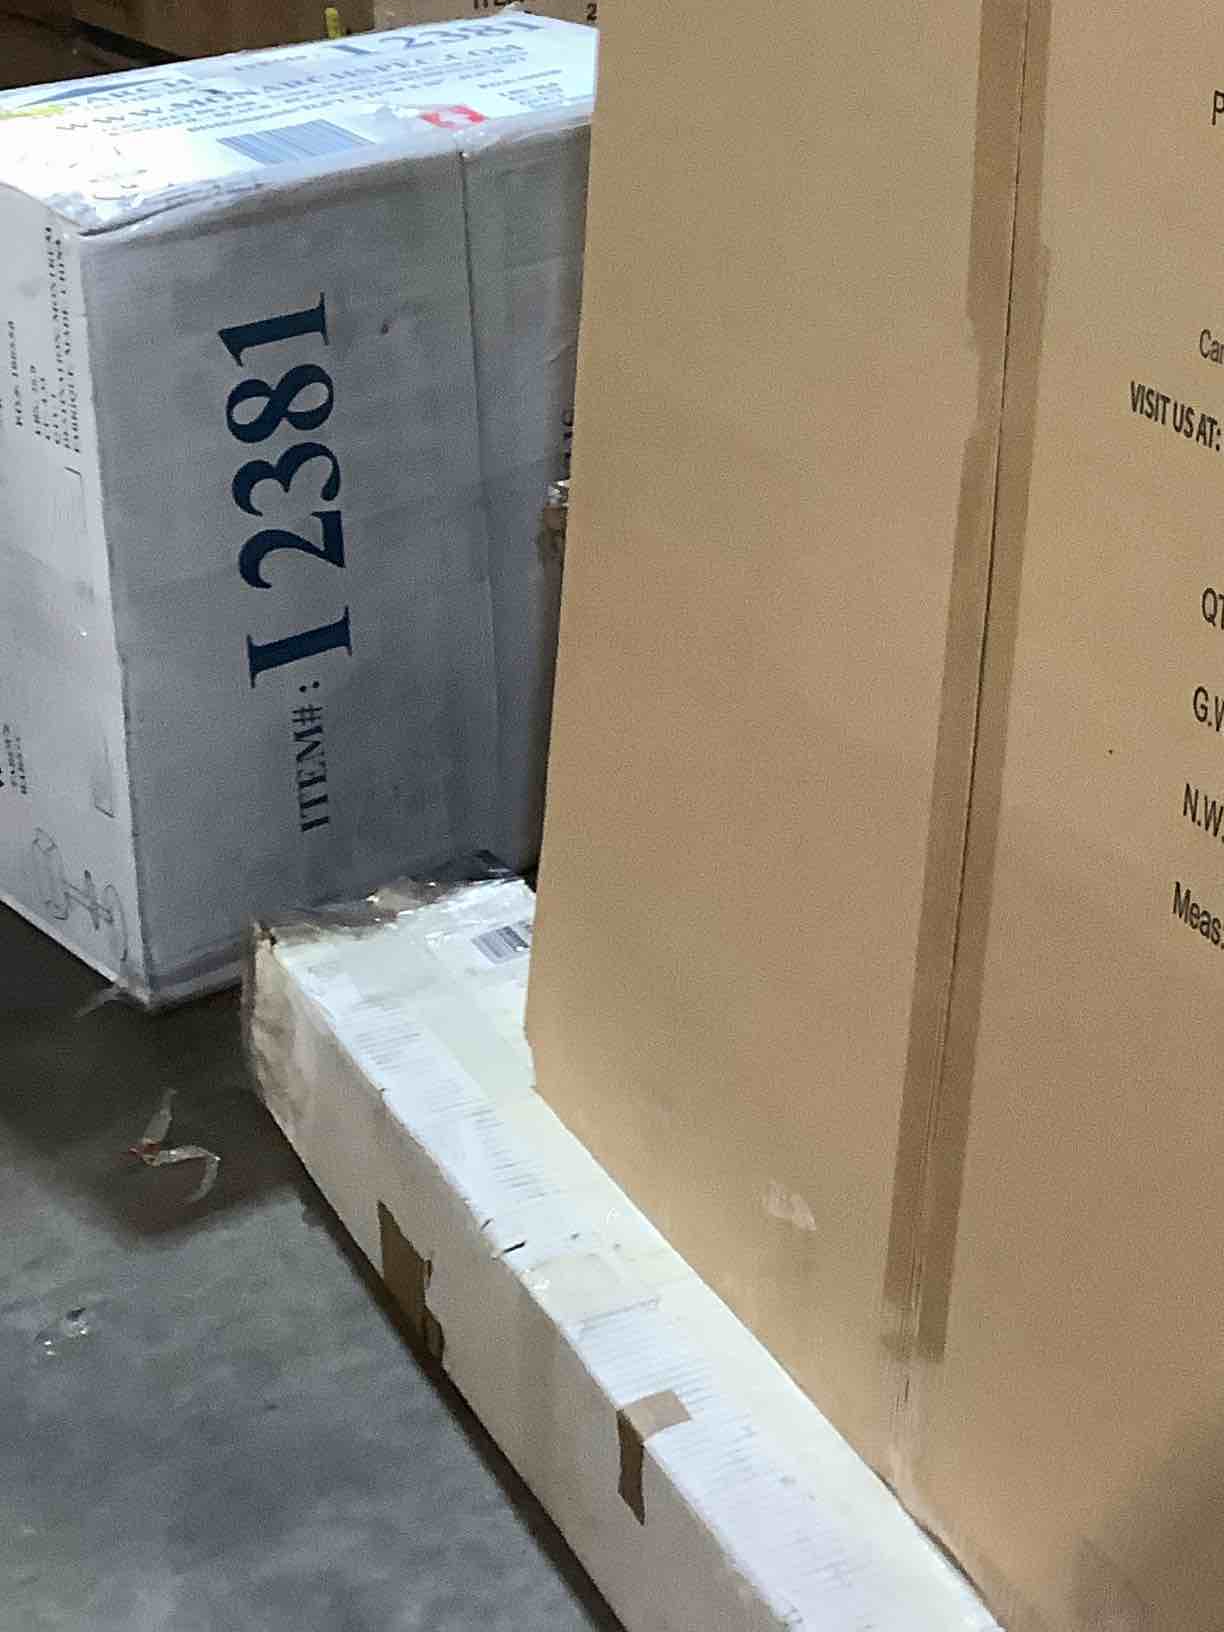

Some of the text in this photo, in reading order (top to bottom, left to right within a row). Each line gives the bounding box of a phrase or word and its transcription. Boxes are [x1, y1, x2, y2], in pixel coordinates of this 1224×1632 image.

[217, 290, 347, 590] 2381
[1130, 380, 1172, 426] VISIT
[1172, 405, 1194, 440] US
[1195, 414, 1221, 452] AT:
